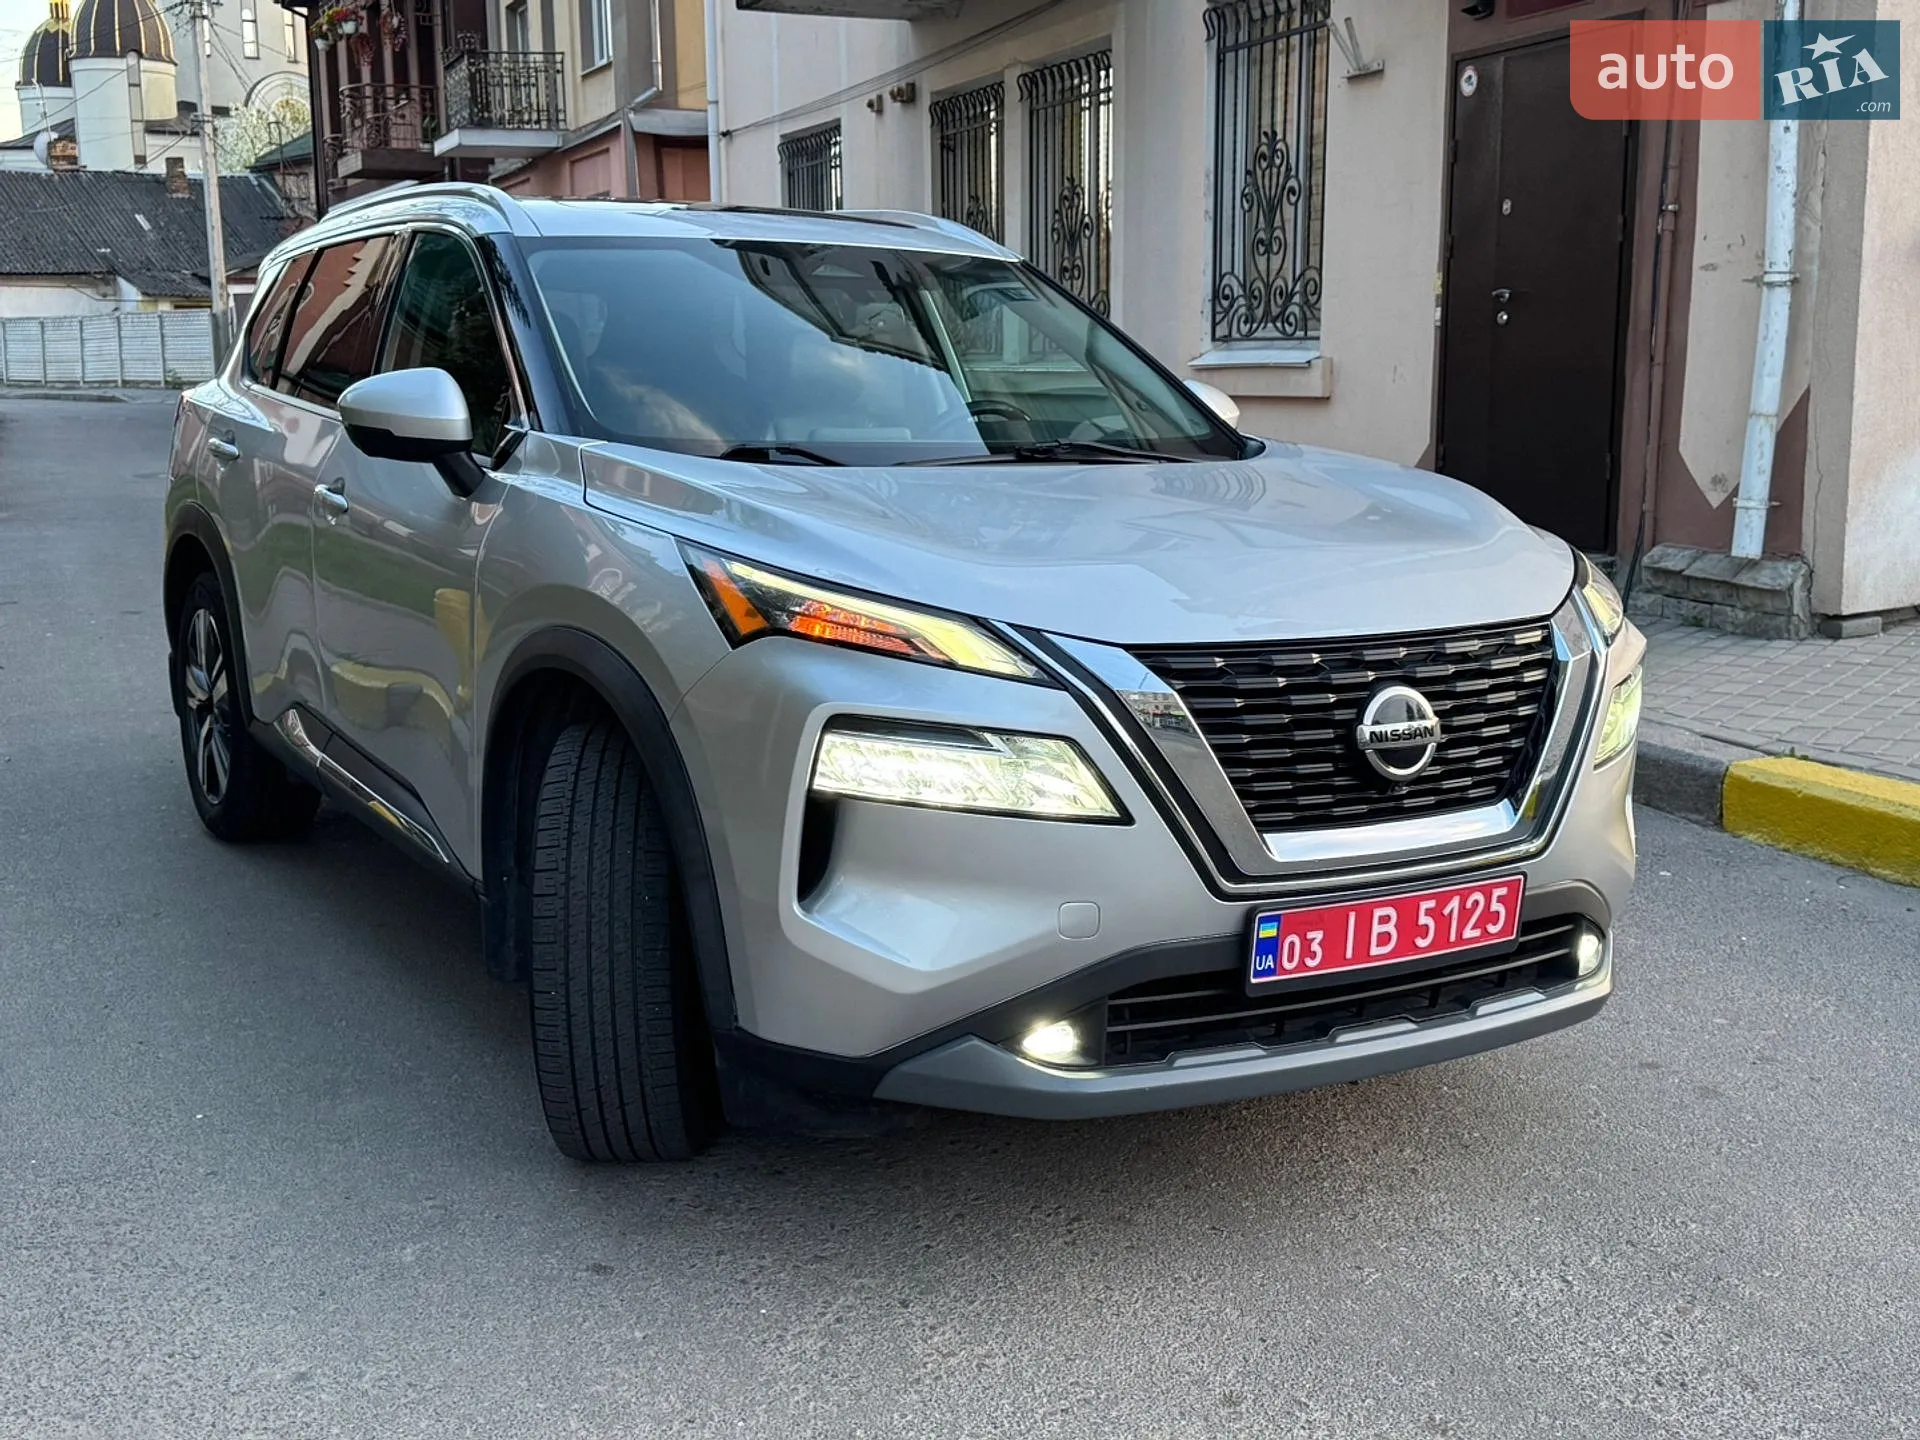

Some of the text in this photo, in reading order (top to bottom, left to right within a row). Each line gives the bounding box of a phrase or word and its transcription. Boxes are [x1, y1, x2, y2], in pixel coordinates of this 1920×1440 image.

[1369, 725, 1435, 743] NISSAN
[1281, 887, 1509, 970] 03 IB 5125
[1255, 953, 1275, 971] UA
